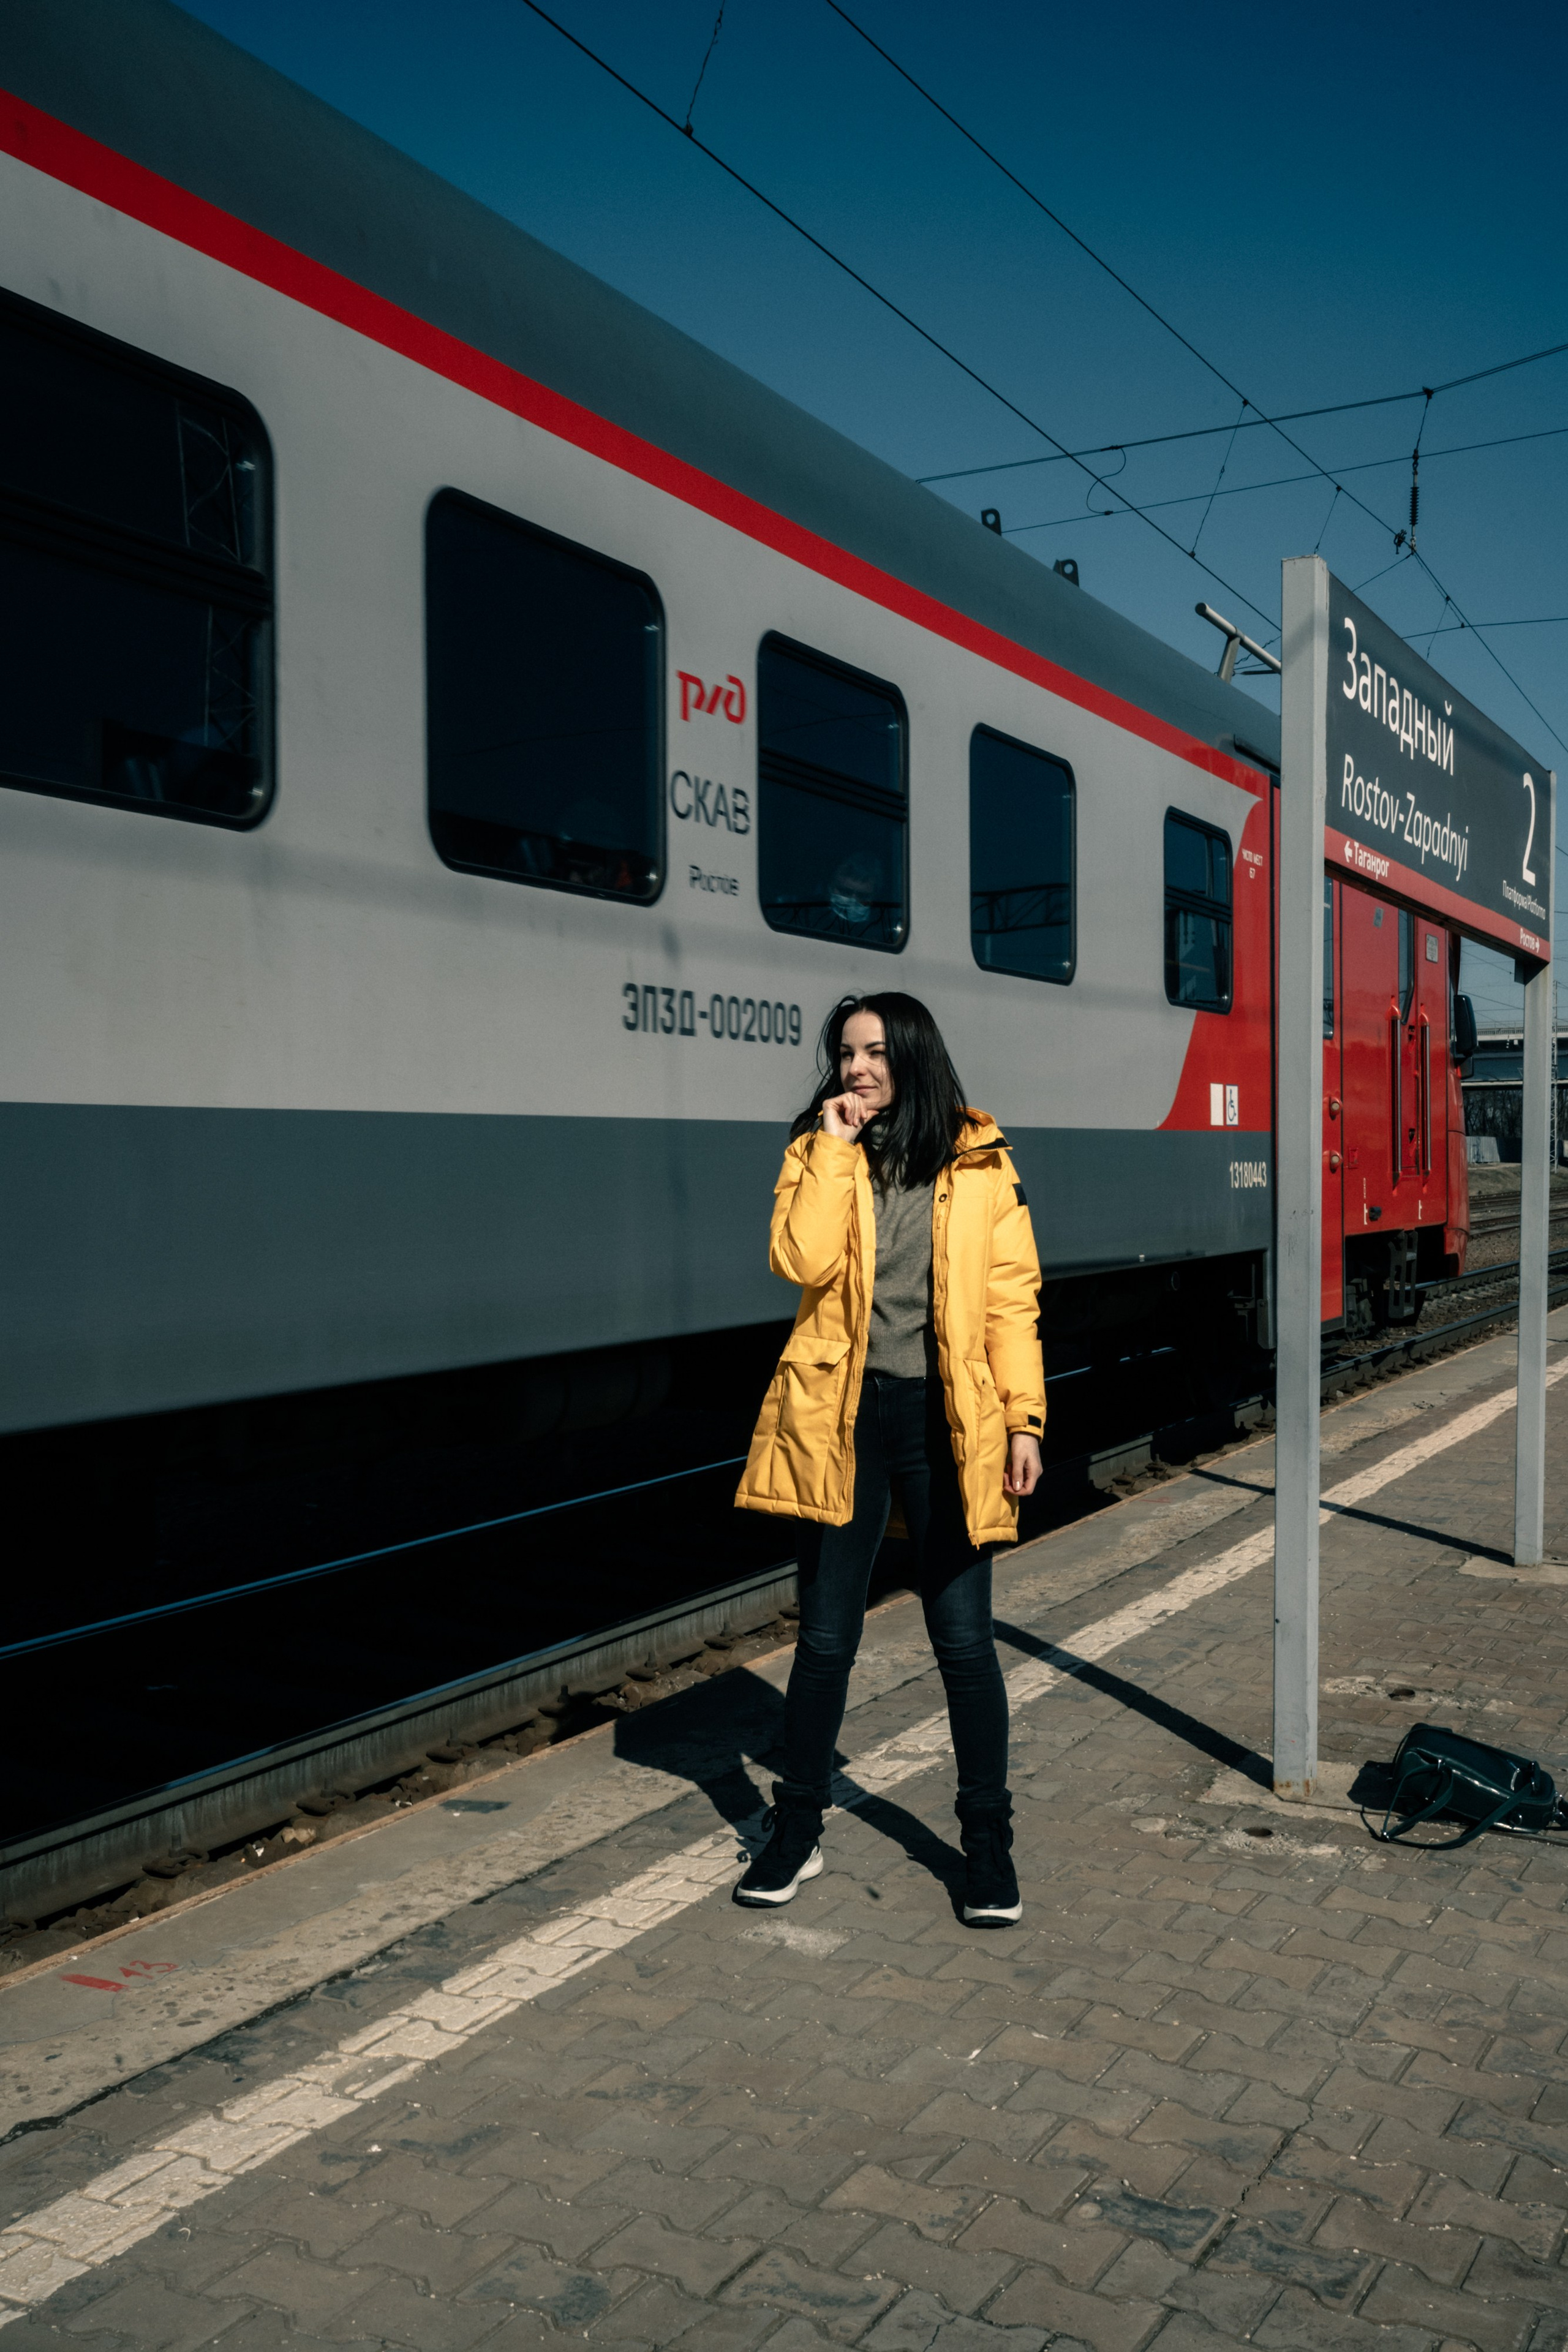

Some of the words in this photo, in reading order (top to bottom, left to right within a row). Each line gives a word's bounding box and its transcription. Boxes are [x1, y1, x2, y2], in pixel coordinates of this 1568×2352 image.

[1343, 617, 1453, 776] Западный
[671, 770, 751, 835] СКАВ
[1341, 753, 1469, 882] Rostov-Zapadnyi
[1523, 772, 1536, 886] 2
[1354, 841, 1390, 880] Таганрог
[1520, 927, 1536, 951] Ростов
[1229, 1161, 1267, 1188] 13180443
